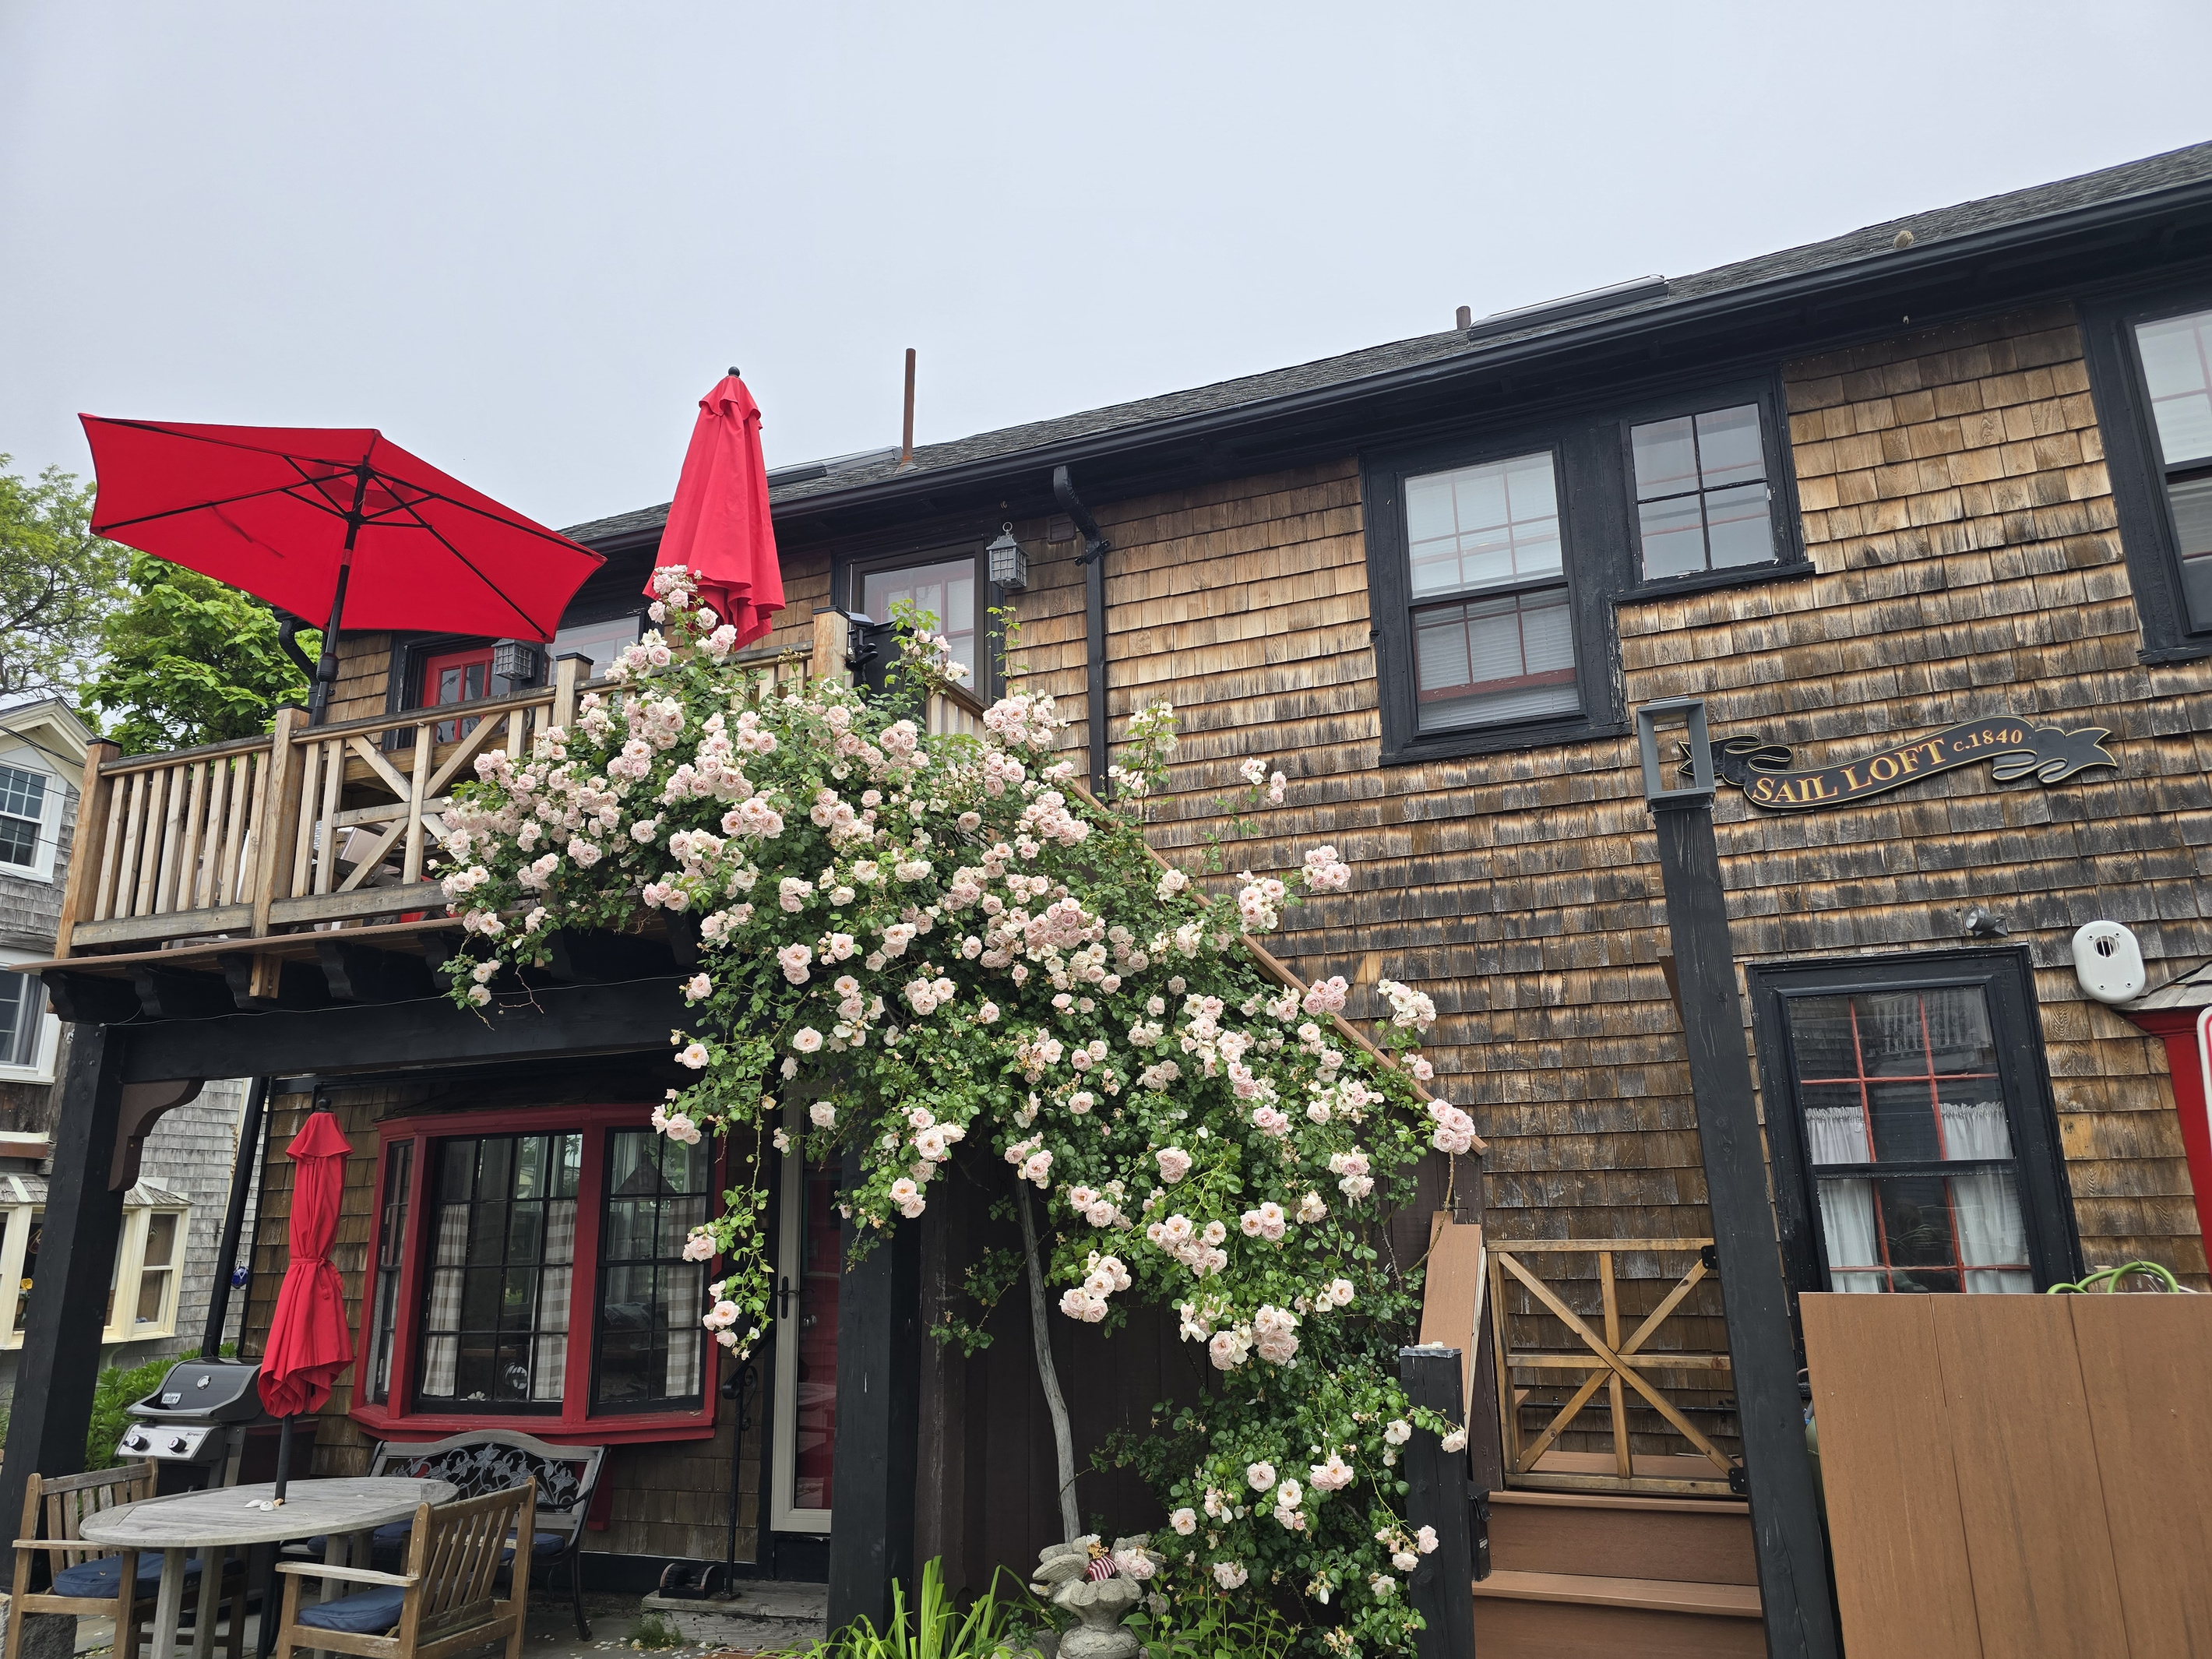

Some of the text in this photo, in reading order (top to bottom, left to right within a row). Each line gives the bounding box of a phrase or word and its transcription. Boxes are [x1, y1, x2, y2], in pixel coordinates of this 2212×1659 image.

[1752, 728, 2023, 803] SAIL LOFT c.1840
